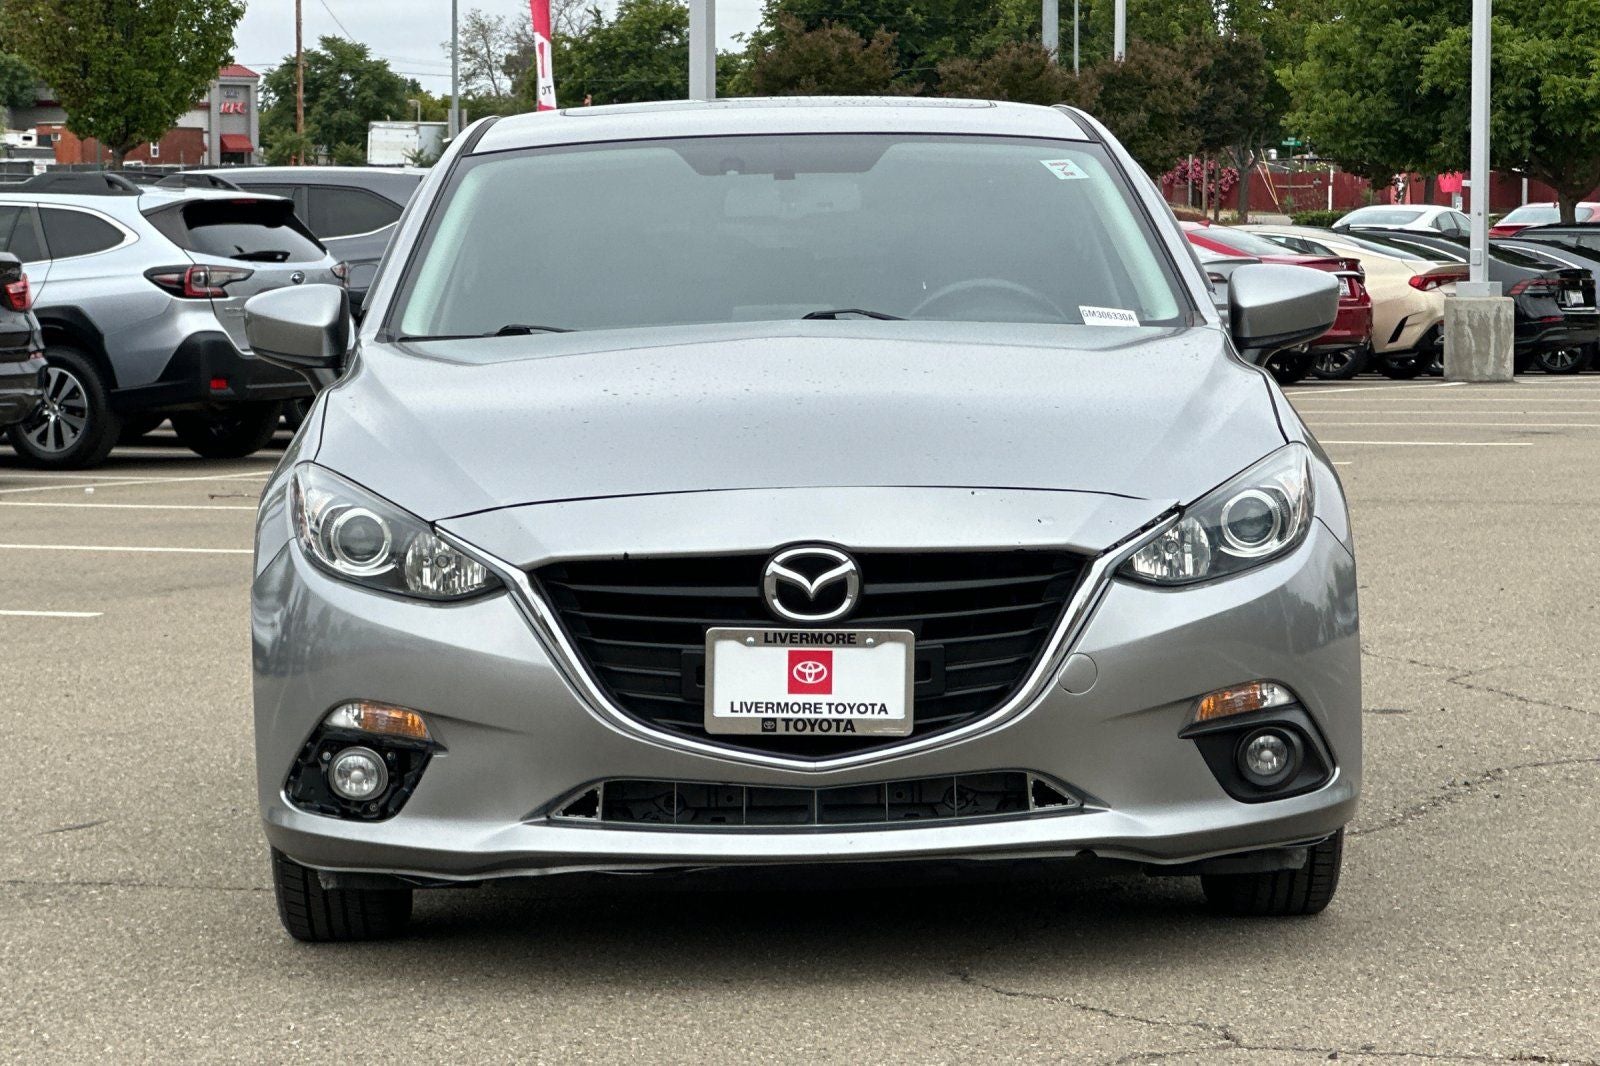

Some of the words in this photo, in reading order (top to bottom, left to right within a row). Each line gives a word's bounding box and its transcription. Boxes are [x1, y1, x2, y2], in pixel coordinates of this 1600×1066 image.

[763, 632, 857, 645] LIVERMORE
[729, 701, 823, 714] LIVERMORE
[826, 702, 889, 715] TOYOTA
[781, 718, 857, 733] TOYOTA
